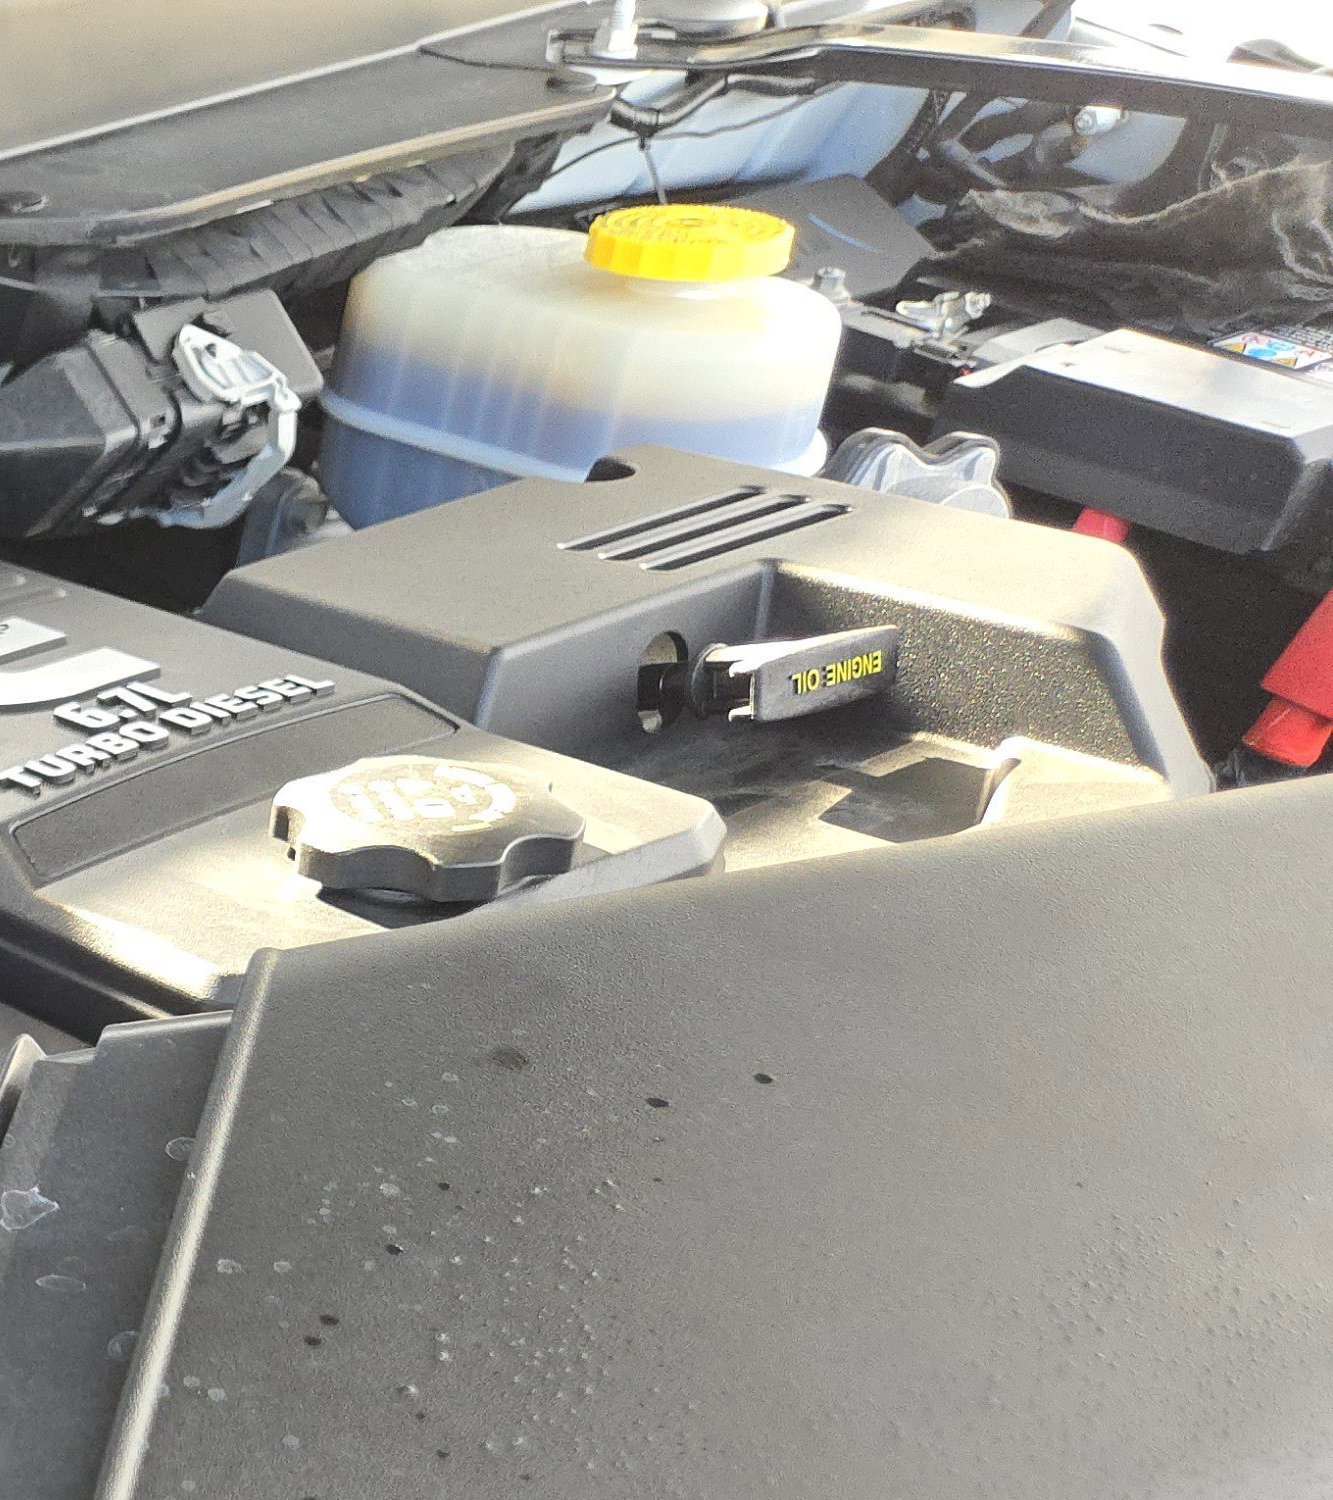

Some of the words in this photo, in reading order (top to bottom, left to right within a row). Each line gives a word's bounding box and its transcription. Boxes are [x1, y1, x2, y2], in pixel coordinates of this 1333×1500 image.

[792, 668, 820, 695] OIL
[826, 649, 882, 687] ENGINE
[54, 682, 194, 734] 6.7L
[158, 673, 336, 736] DIESEL
